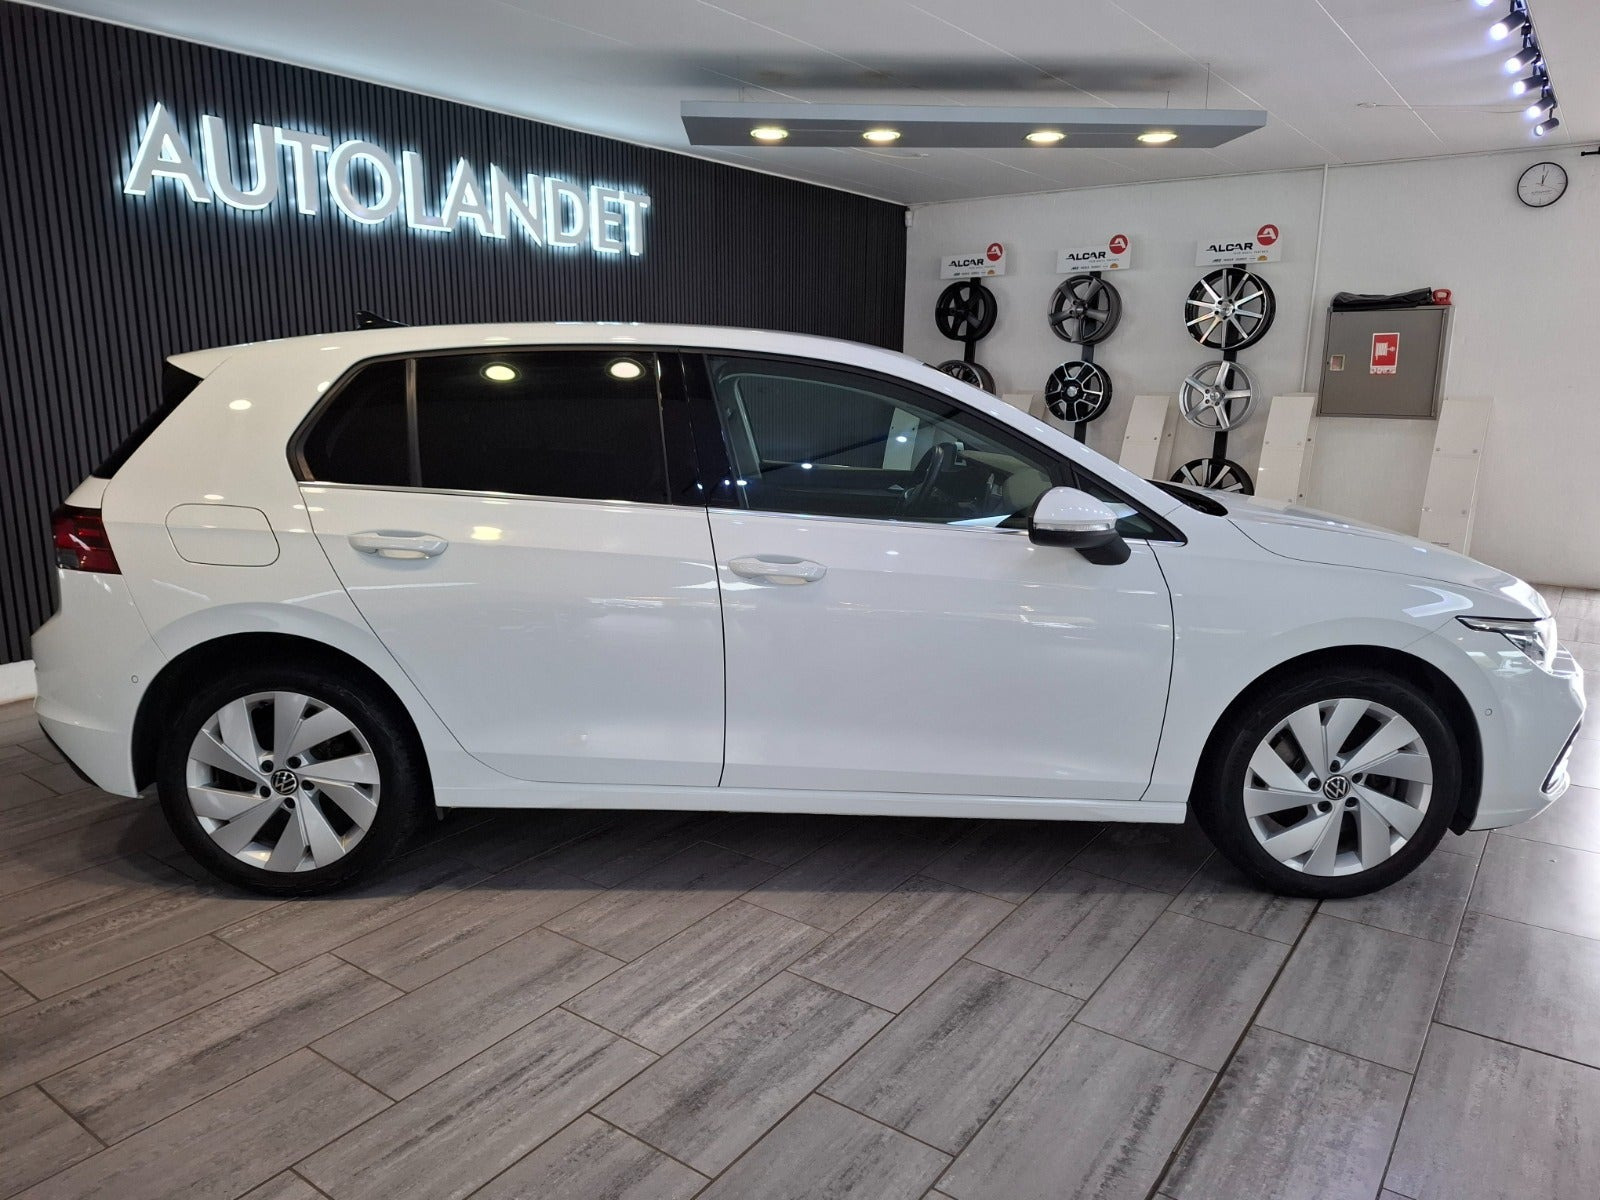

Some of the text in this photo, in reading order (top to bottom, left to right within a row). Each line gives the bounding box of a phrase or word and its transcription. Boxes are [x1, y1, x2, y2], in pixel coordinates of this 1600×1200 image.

[124, 101, 651, 256] AUTOLANDET
[1206, 242, 1254, 253] ALCAR
[1065, 251, 1106, 261] ALCAR
[948, 258, 985, 268] ALCAR
